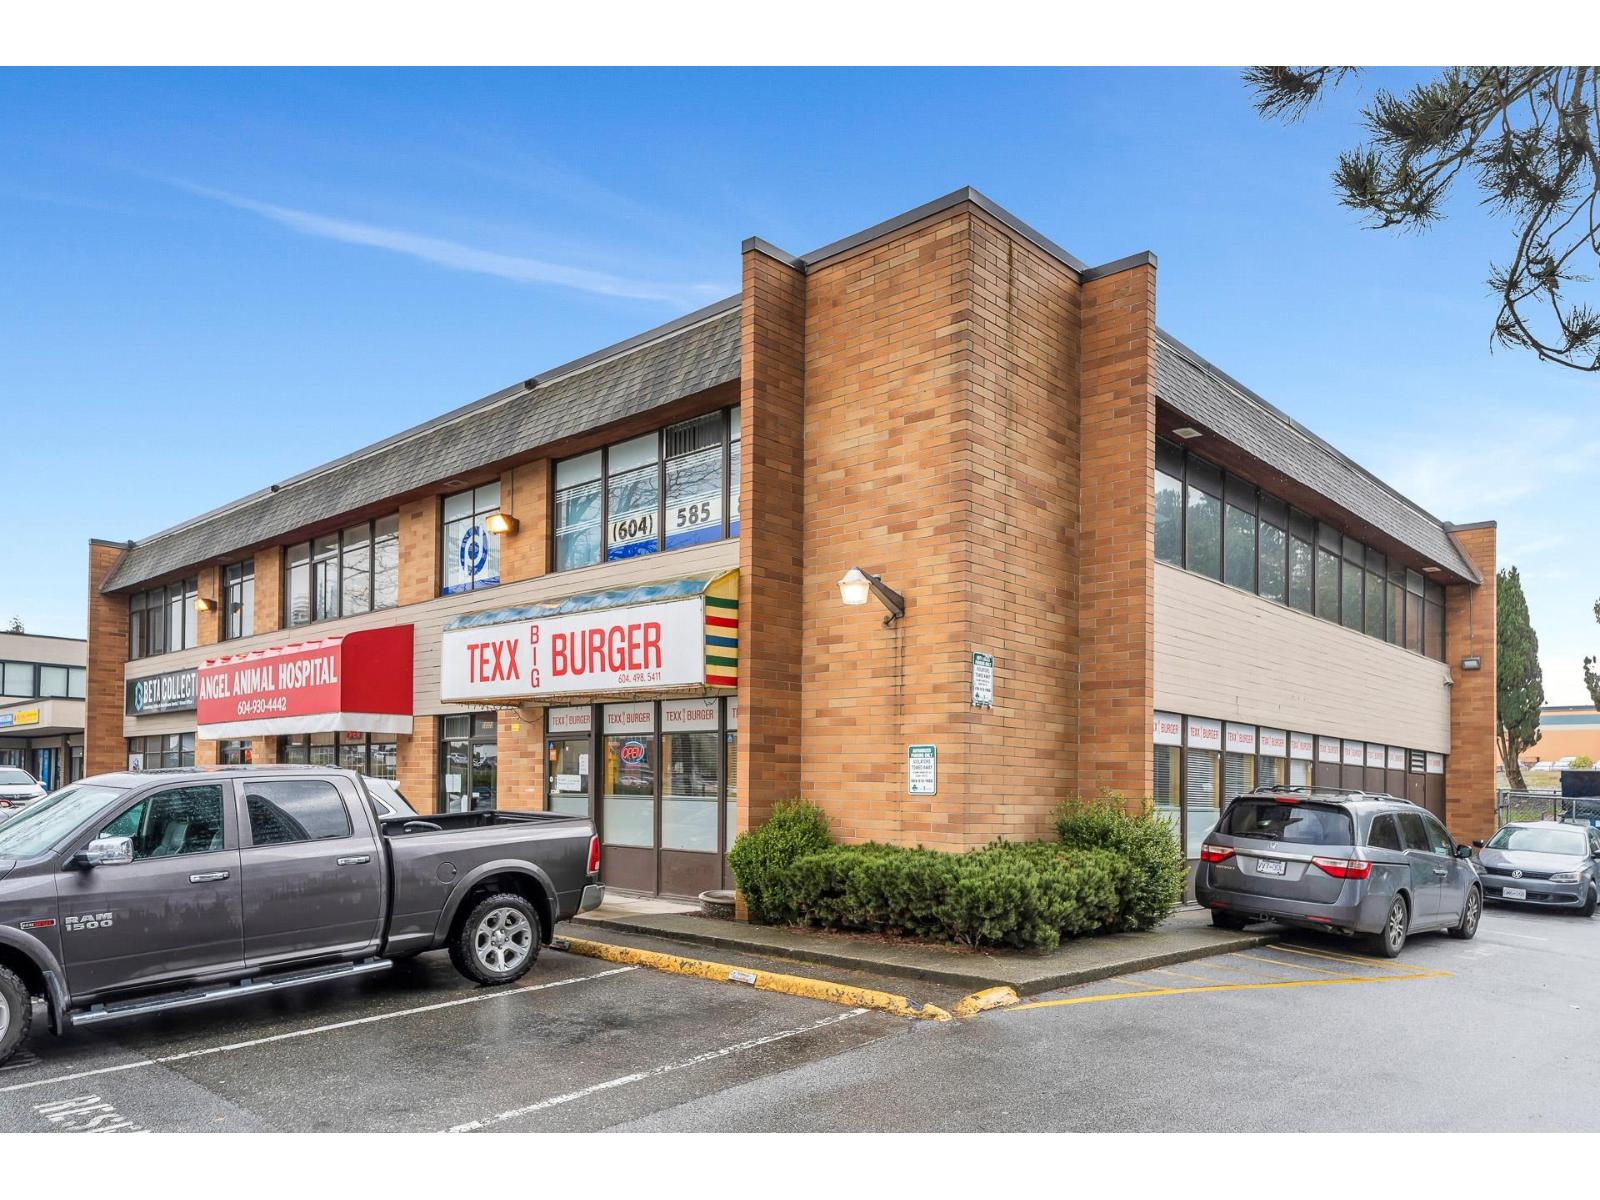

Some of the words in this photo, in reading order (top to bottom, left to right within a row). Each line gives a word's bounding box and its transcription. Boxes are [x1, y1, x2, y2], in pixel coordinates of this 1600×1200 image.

[613, 514, 653, 542] (604)
[677, 502, 710, 528] 585
[467, 639, 520, 683] TEXX
[551, 621, 662, 677] BURGER
[199, 673, 231, 700] ANGEL
[233, 666, 275, 697] ANIMAL
[278, 655, 338, 690] HOSPITAL
[143, 678, 161, 704] BETA
[237, 696, 287, 715] 604-930-4442
[569, 714, 591, 725] BURGER
[608, 713, 622, 724] TEXX
[626, 712, 651, 723] BURGER
[666, 710, 682, 721] TEXX
[687, 709, 714, 721] BURGER
[621, 747, 641, 759] OPEN
[65, 912, 112, 924] RAM
[65, 920, 113, 932] 1500
